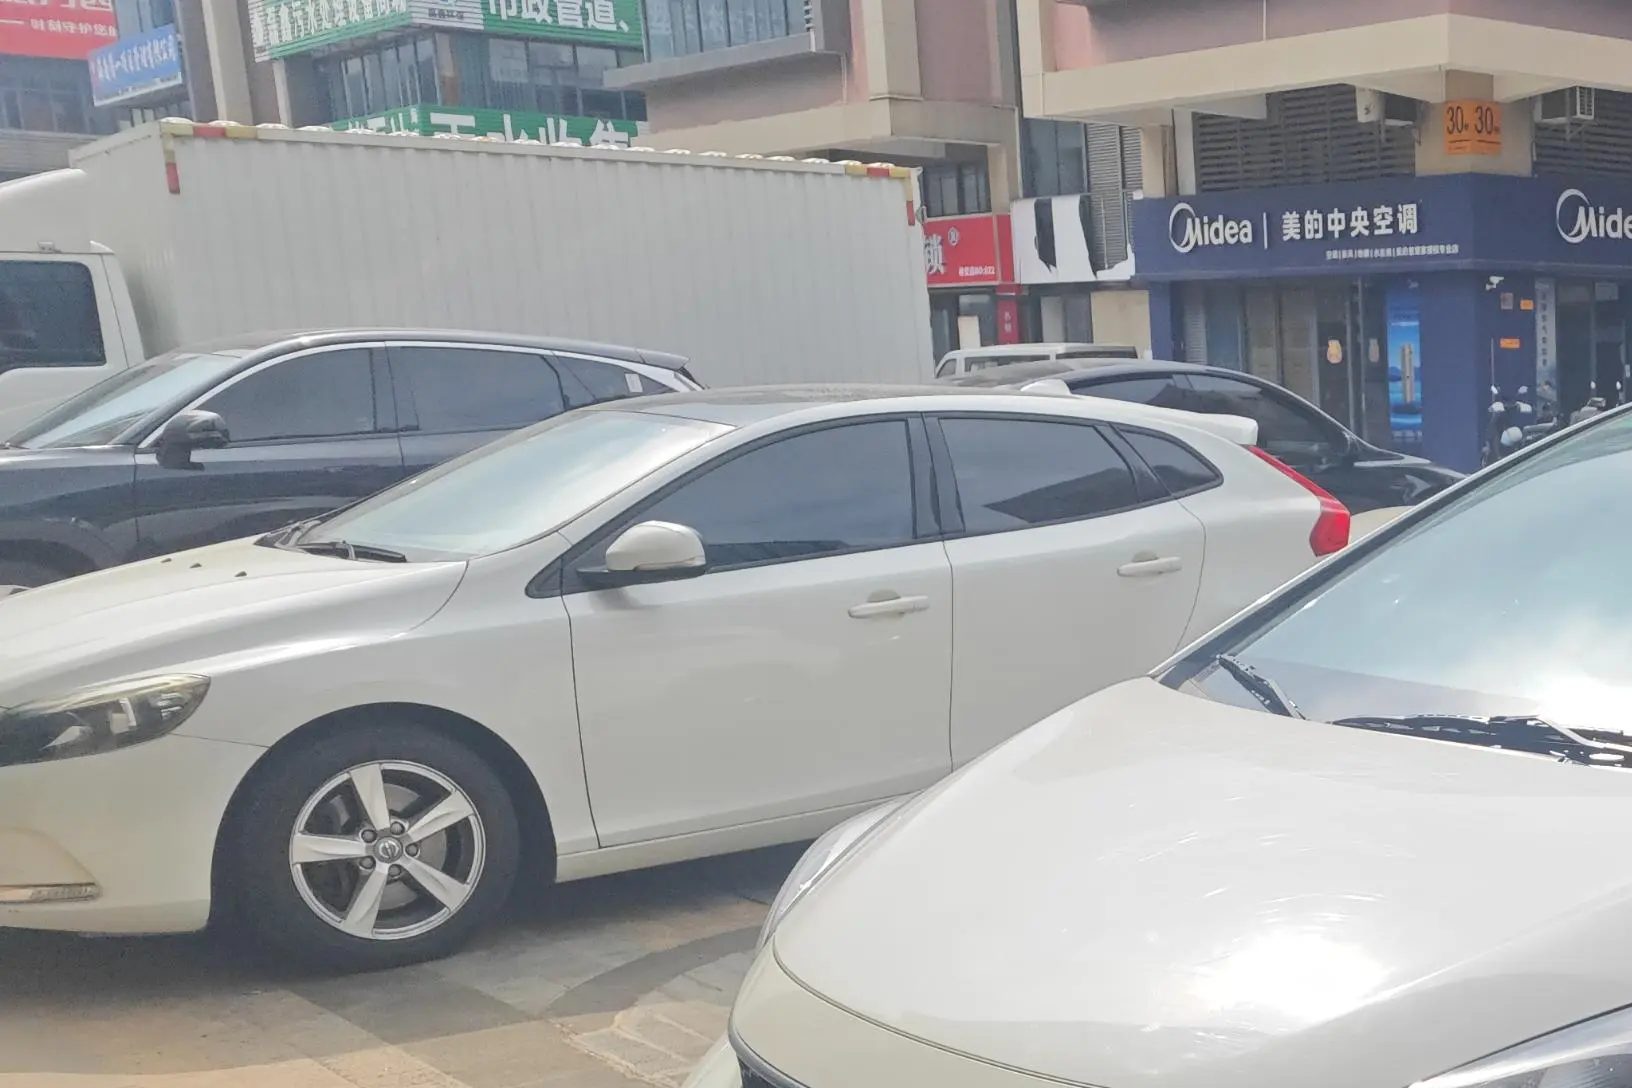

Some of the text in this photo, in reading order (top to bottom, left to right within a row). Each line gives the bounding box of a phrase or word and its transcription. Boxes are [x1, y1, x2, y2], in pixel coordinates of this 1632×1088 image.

[1169, 202, 1418, 253] Midea 美的中央空调
